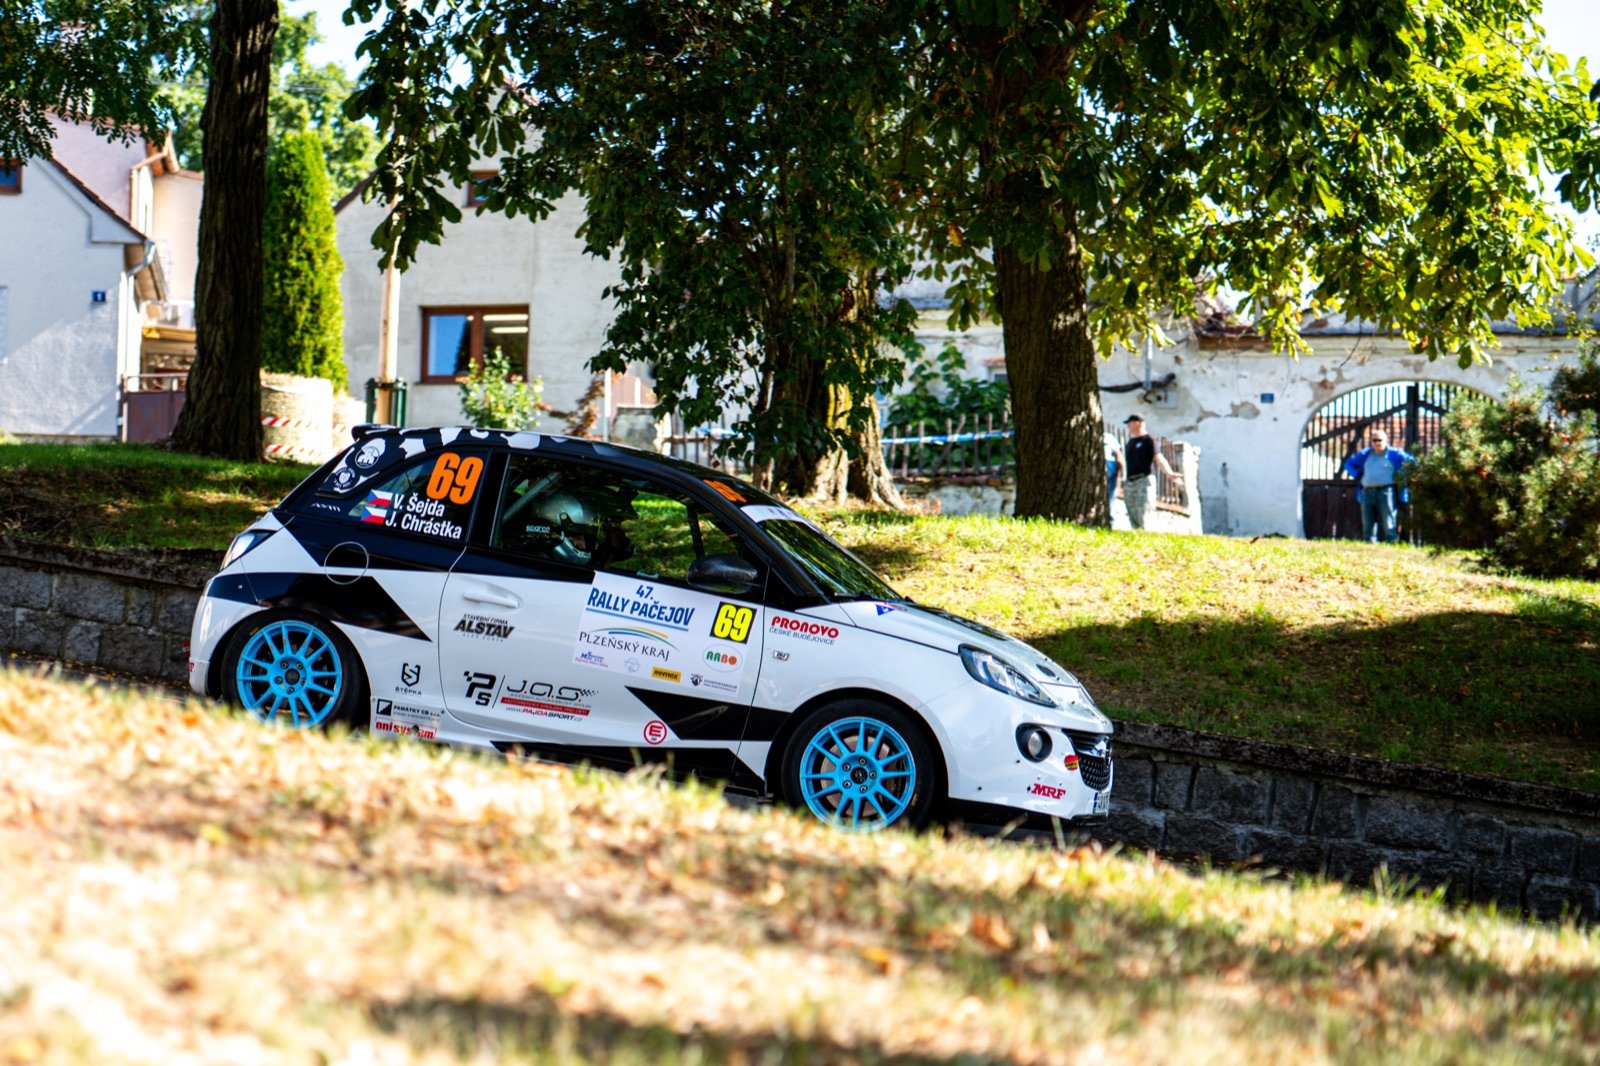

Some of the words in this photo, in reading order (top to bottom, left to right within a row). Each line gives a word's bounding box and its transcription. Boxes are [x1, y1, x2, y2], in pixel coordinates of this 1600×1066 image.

[426, 452, 484, 505] 69
[393, 493, 405, 510] V.
[406, 493, 446, 517] Šejda
[385, 511, 398, 528] J.
[401, 513, 463, 540] Chrástka
[636, 584, 655, 601] 47.
[587, 587, 630, 613] RALLY
[630, 600, 696, 626] PAČEJOV
[453, 618, 515, 640] ALSTAV
[713, 604, 753, 642] 69
[771, 615, 840, 639] PRONOVO
[579, 631, 640, 653] PLZEŇSKÝ
[641, 644, 670, 662] KRAJ
[792, 631, 835, 646] BUDĚJOVICE
[1031, 783, 1067, 800] MRF
